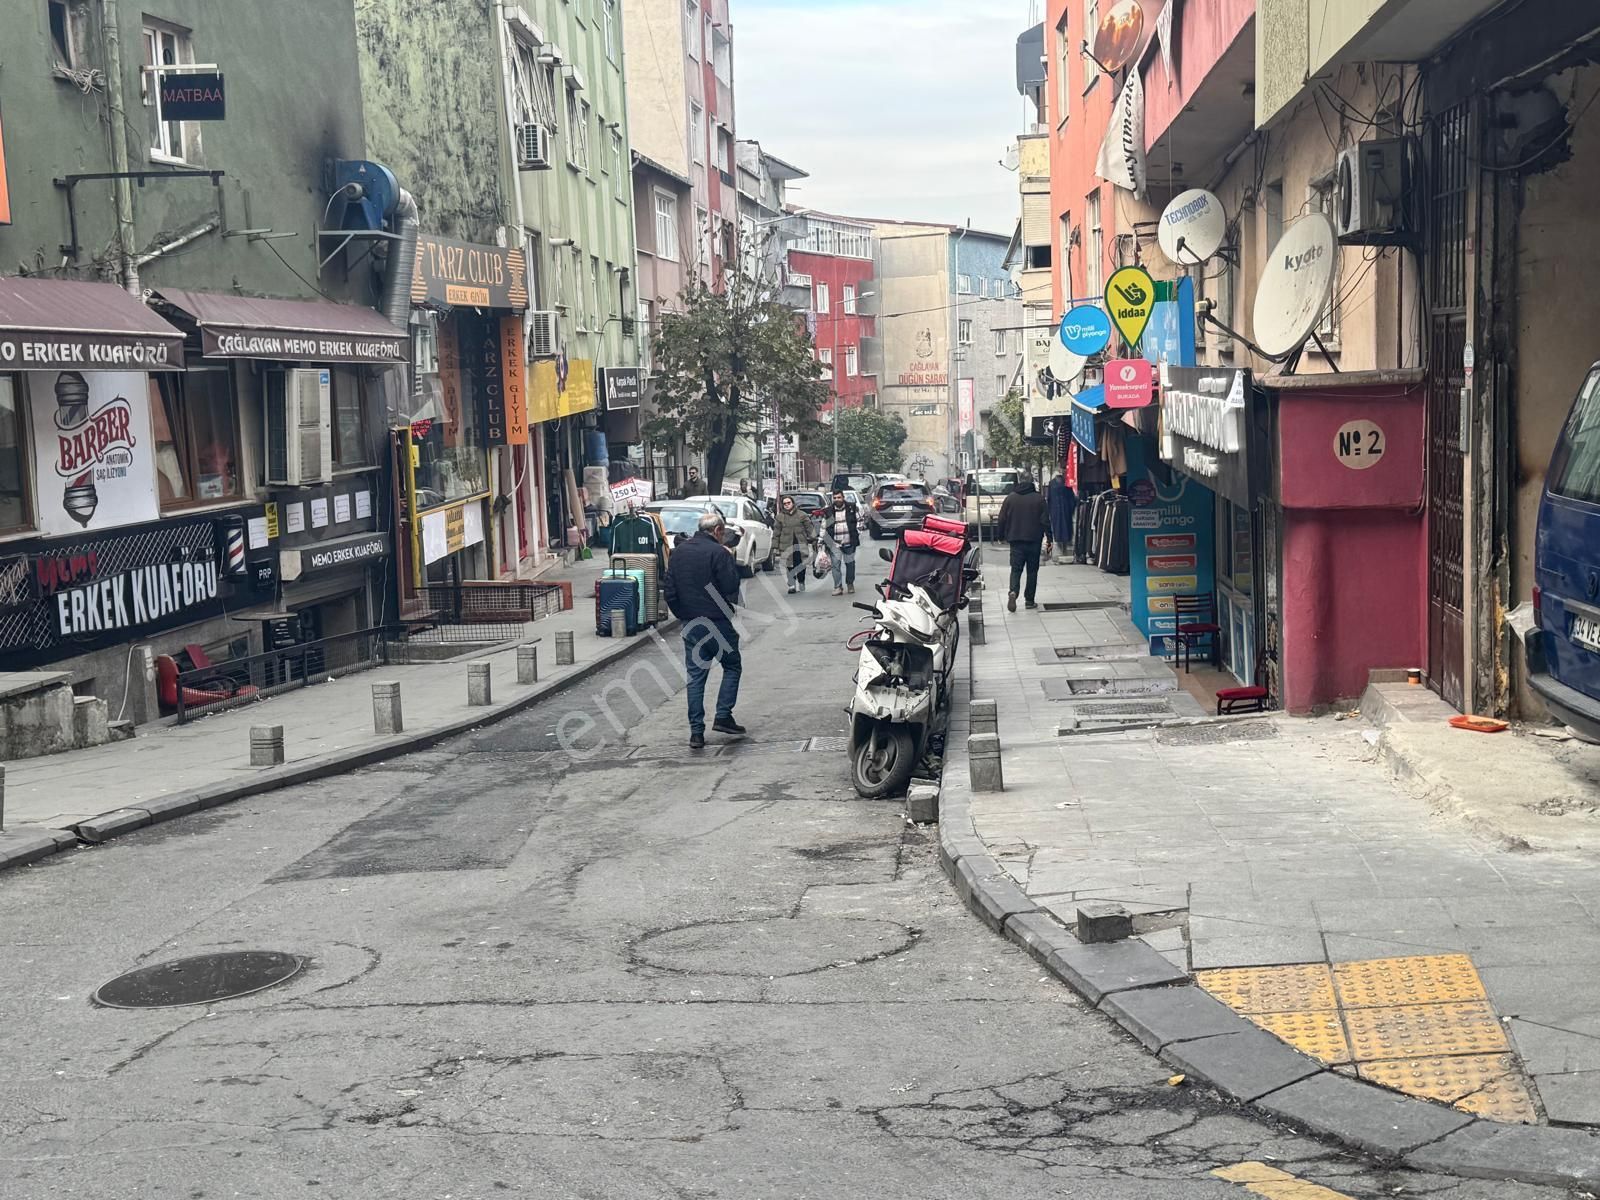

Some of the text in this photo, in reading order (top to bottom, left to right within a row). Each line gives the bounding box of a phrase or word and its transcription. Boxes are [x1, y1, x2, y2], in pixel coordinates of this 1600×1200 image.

[164, 88, 222, 102] MATBAA
[1165, 194, 1208, 226] TECHNOBOX
[427, 242, 504, 285] TARZ CLUB
[448, 289, 468, 301] ERKEK
[1118, 308, 1146, 319] iddaa
[22, 343, 84, 363] ERKEK
[89, 342, 168, 364] KUAFÖRÜ
[218, 332, 400, 358] ÇAĞLAYAN MEMO ERKEK KUAFÖRÜ
[507, 328, 518, 377] ERKEK
[483, 323, 501, 439] TARZ CLUB
[58, 406, 136, 471] BARBER
[1368, 431, 1382, 454] 2
[614, 488, 629, 498] 250
[312, 540, 383, 567] MEMO ERKEK KUAFÖRÜ
[259, 568, 271, 580] PRP
[58, 547, 217, 635] ERKEK KUAFÖRÜ
